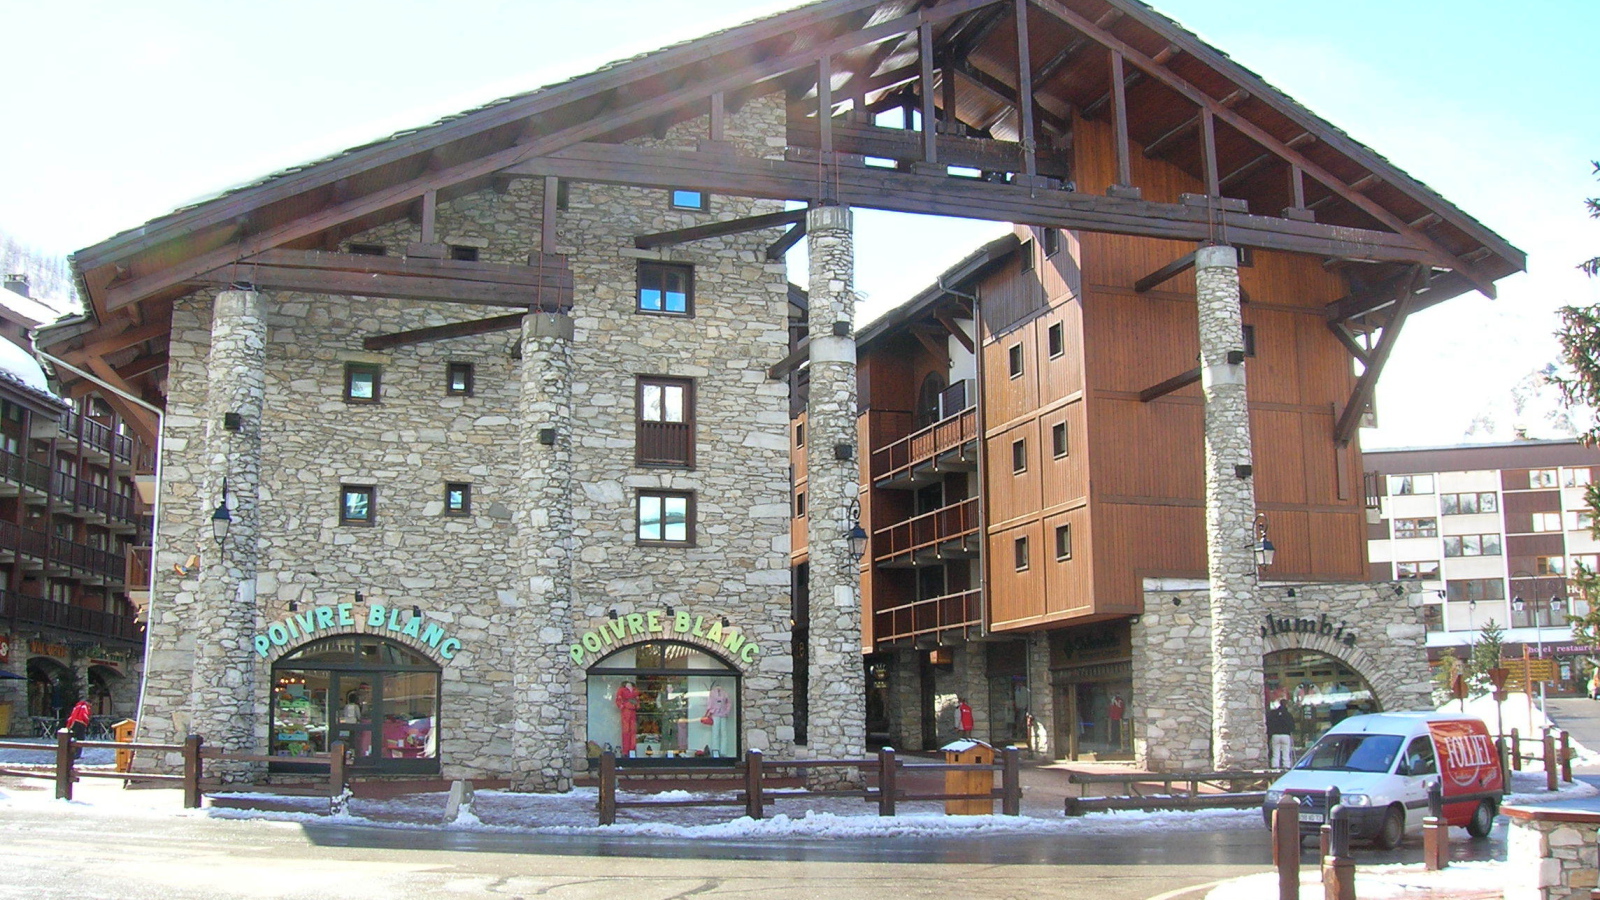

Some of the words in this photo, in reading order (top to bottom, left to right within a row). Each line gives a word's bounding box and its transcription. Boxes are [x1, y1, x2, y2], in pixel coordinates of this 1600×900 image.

[255, 602, 355, 658] POIVRE
[367, 604, 462, 660] BLANC
[570, 610, 664, 665] POIVRE
[674, 611, 760, 663] BLANC
[1444, 735, 1491, 768] FOLLIET
